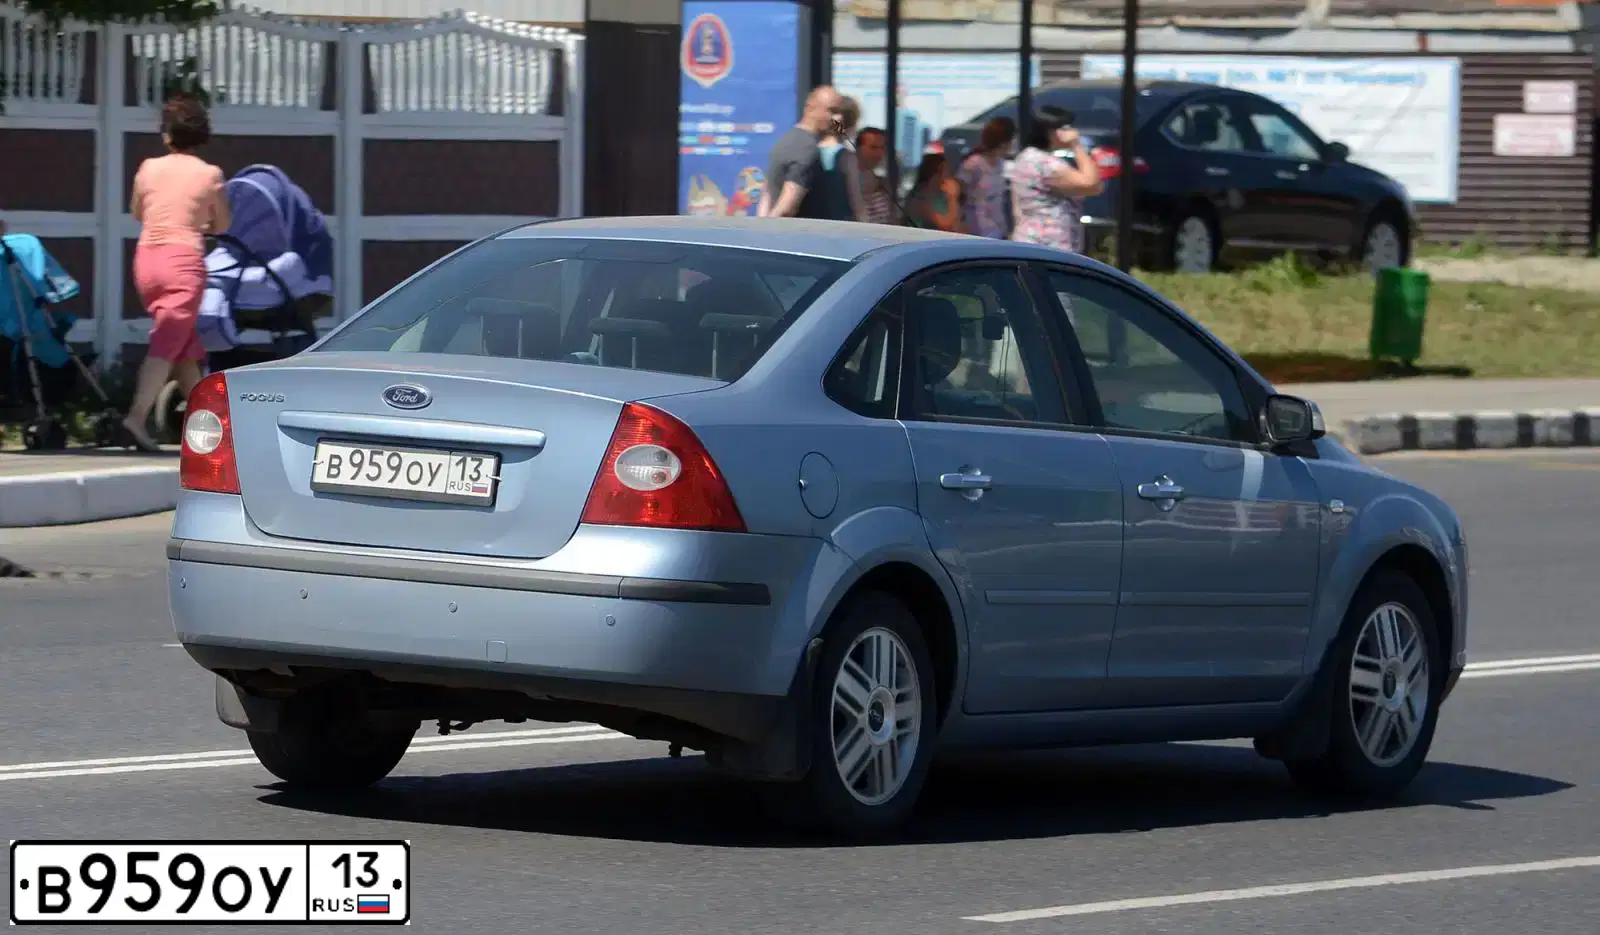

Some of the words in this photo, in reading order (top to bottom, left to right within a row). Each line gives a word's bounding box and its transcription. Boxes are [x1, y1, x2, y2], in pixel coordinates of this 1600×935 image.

[240, 392, 286, 403] FOCUS
[391, 388, 419, 403] Ford
[455, 456, 483, 482] 13
[449, 481, 471, 492] RUS
